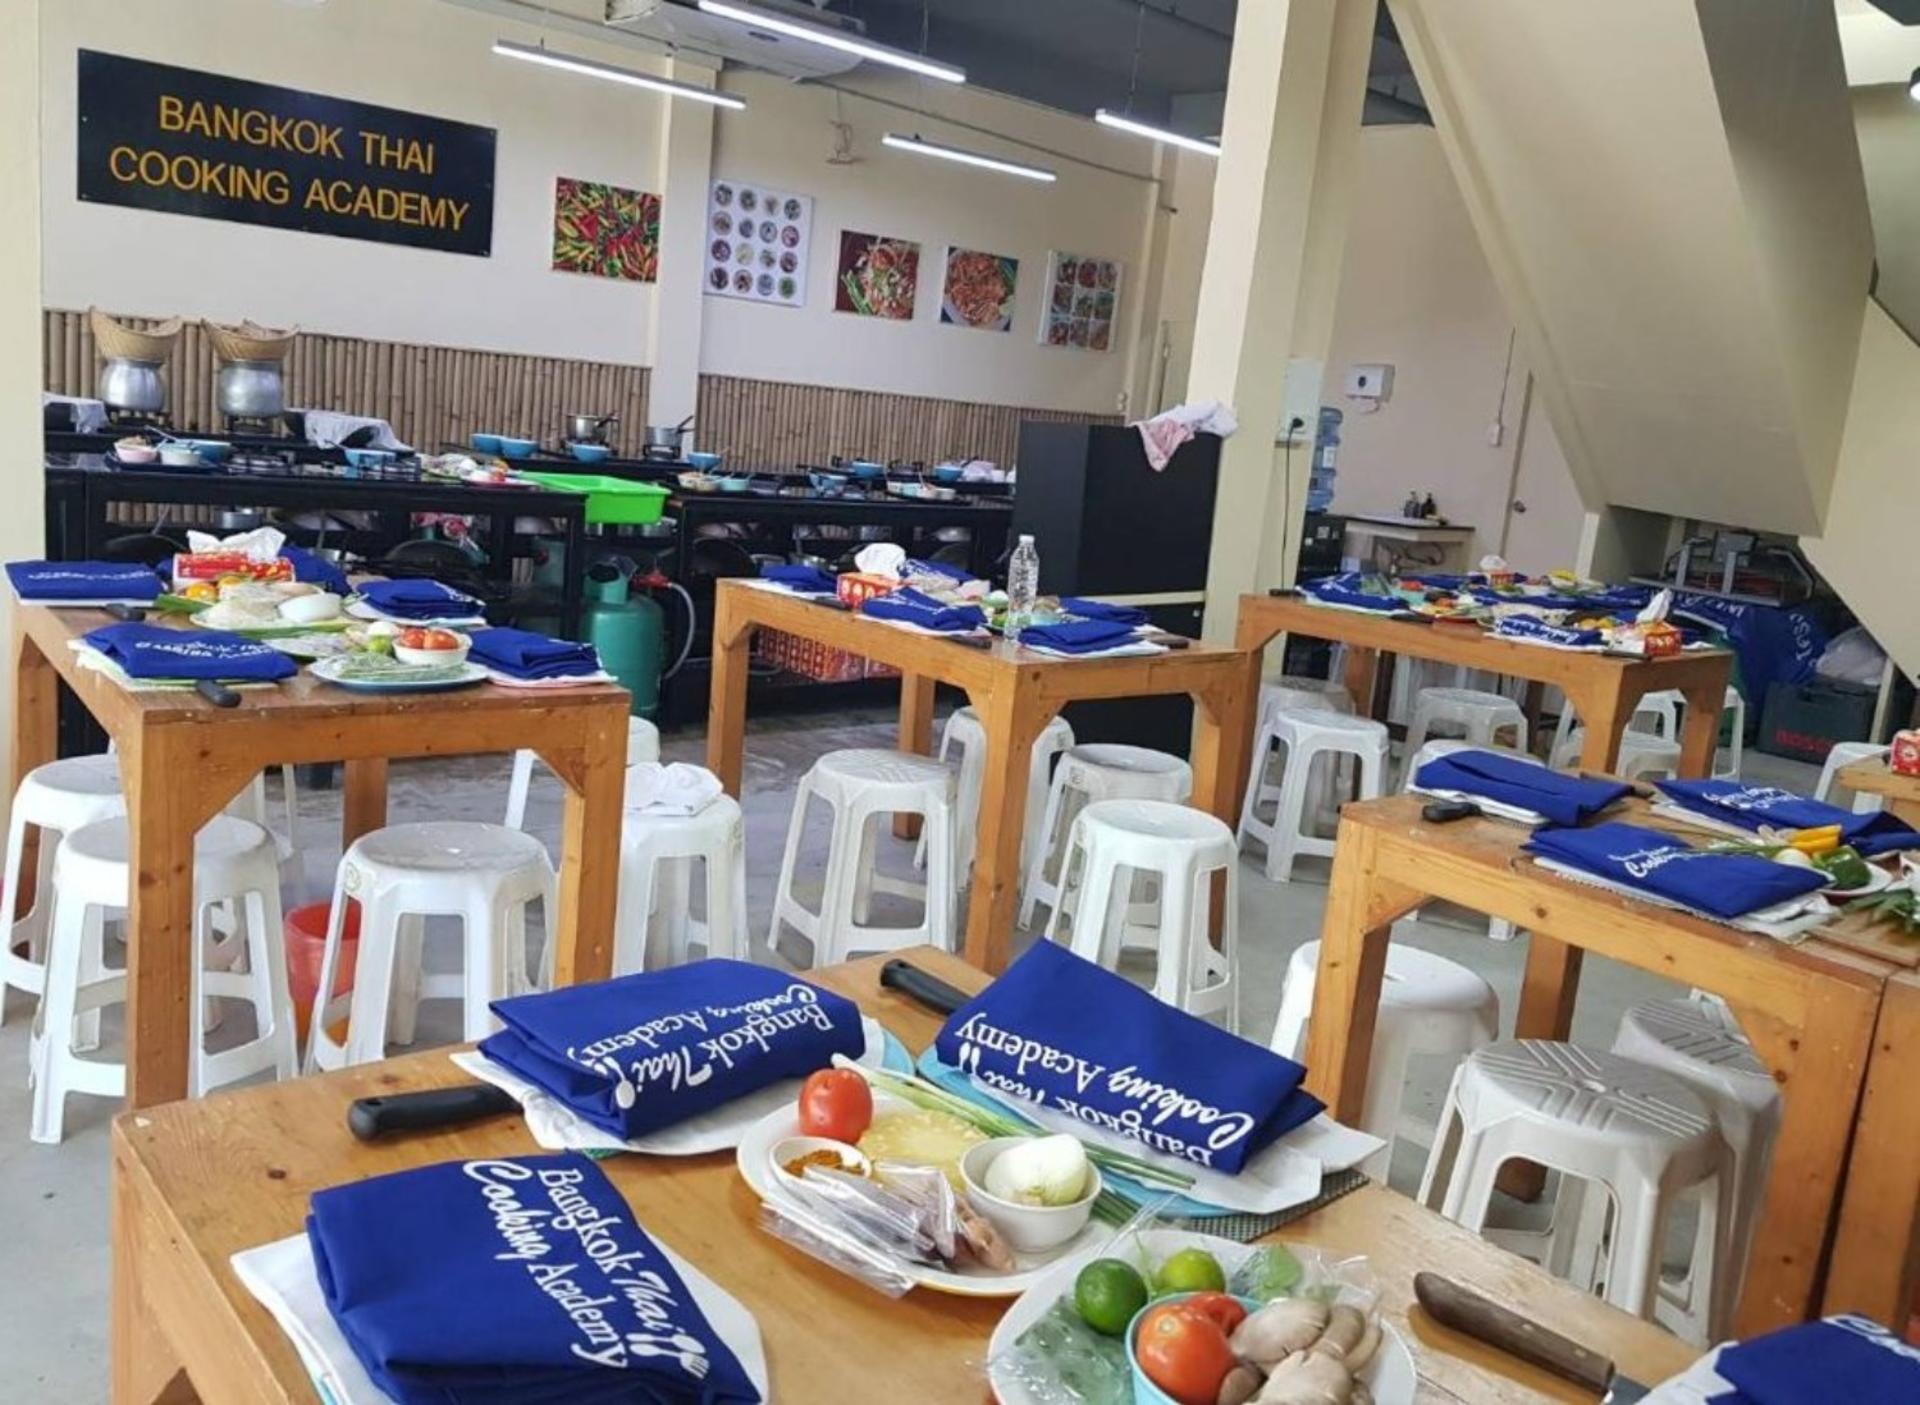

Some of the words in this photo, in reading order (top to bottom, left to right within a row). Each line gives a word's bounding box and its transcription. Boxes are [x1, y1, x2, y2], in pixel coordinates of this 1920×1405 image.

[160, 95, 345, 160] BANGKOK
[359, 131, 434, 175] THAI
[110, 146, 290, 205] COOKING
[304, 178, 470, 231] ACADEMY
[1776, 729, 1833, 755] BOSC
[631, 1044, 713, 1092] Thai
[698, 1003, 835, 1070] Bangkok
[954, 1012, 1106, 1094] Academy
[1107, 1065, 1255, 1151] Cooking
[462, 1160, 553, 1260] Cooking
[526, 1263, 630, 1369] Academy
[537, 1168, 646, 1275] Bangkok
[611, 1270, 686, 1334] Thai
